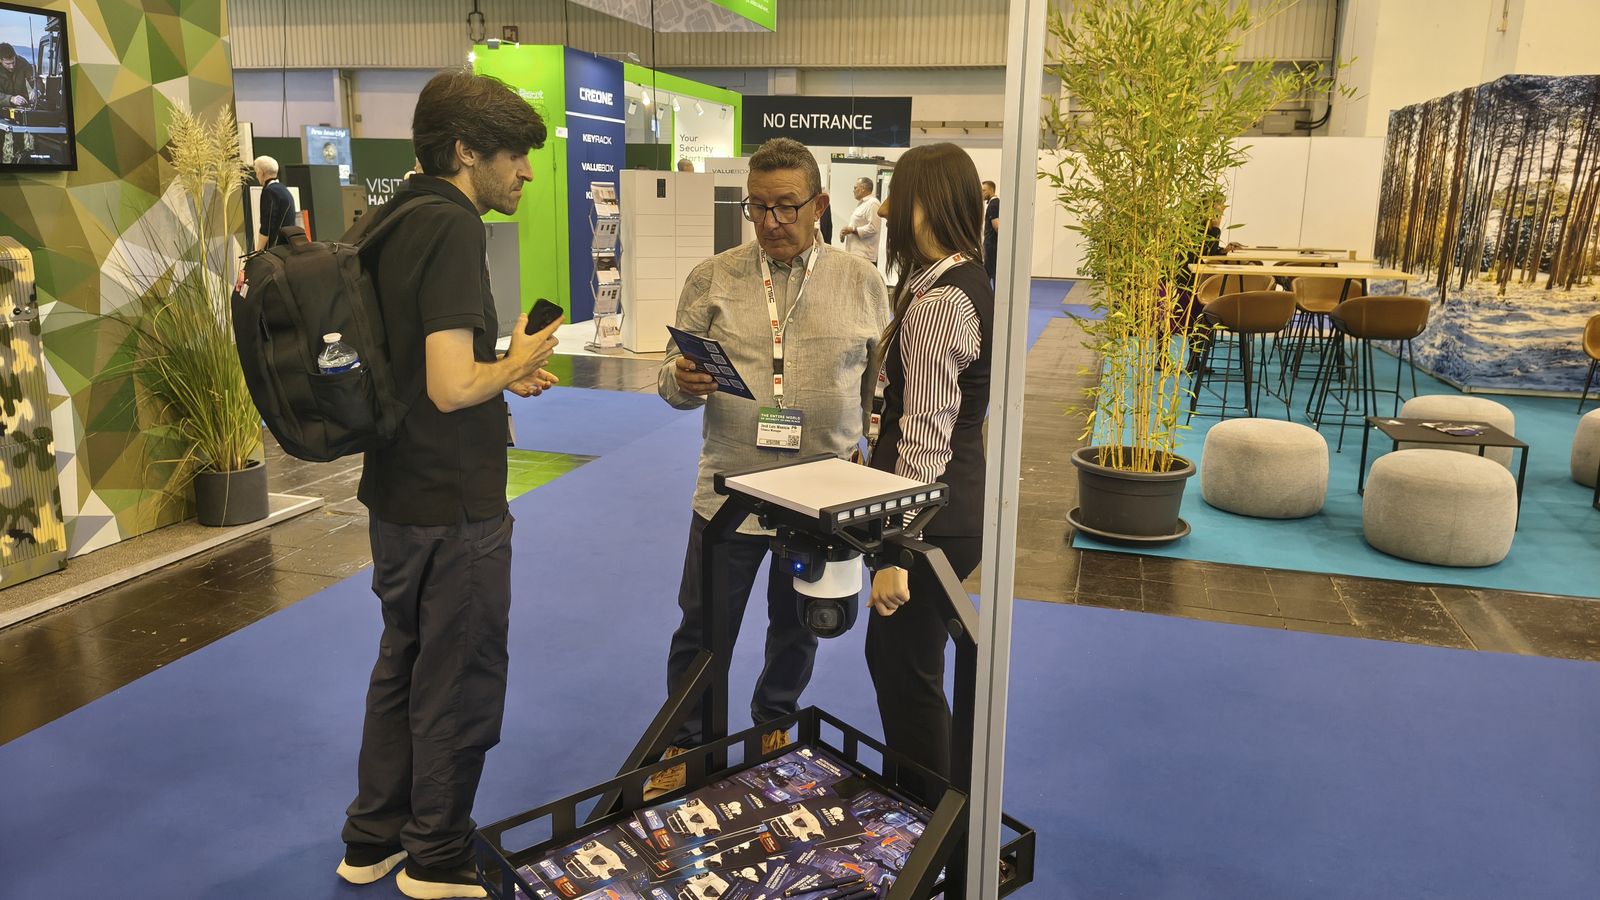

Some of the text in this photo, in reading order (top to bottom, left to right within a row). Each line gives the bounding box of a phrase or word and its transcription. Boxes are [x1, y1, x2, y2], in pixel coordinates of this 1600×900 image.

[579, 87, 613, 106] CREONE
[763, 113, 872, 130] NO ENTRANCE
[582, 133, 612, 145] KEYRACK
[680, 134, 698, 142] Your
[679, 144, 714, 153] Security
[581, 162, 614, 172] VALUEBOX
[366, 178, 403, 193] VISIT
